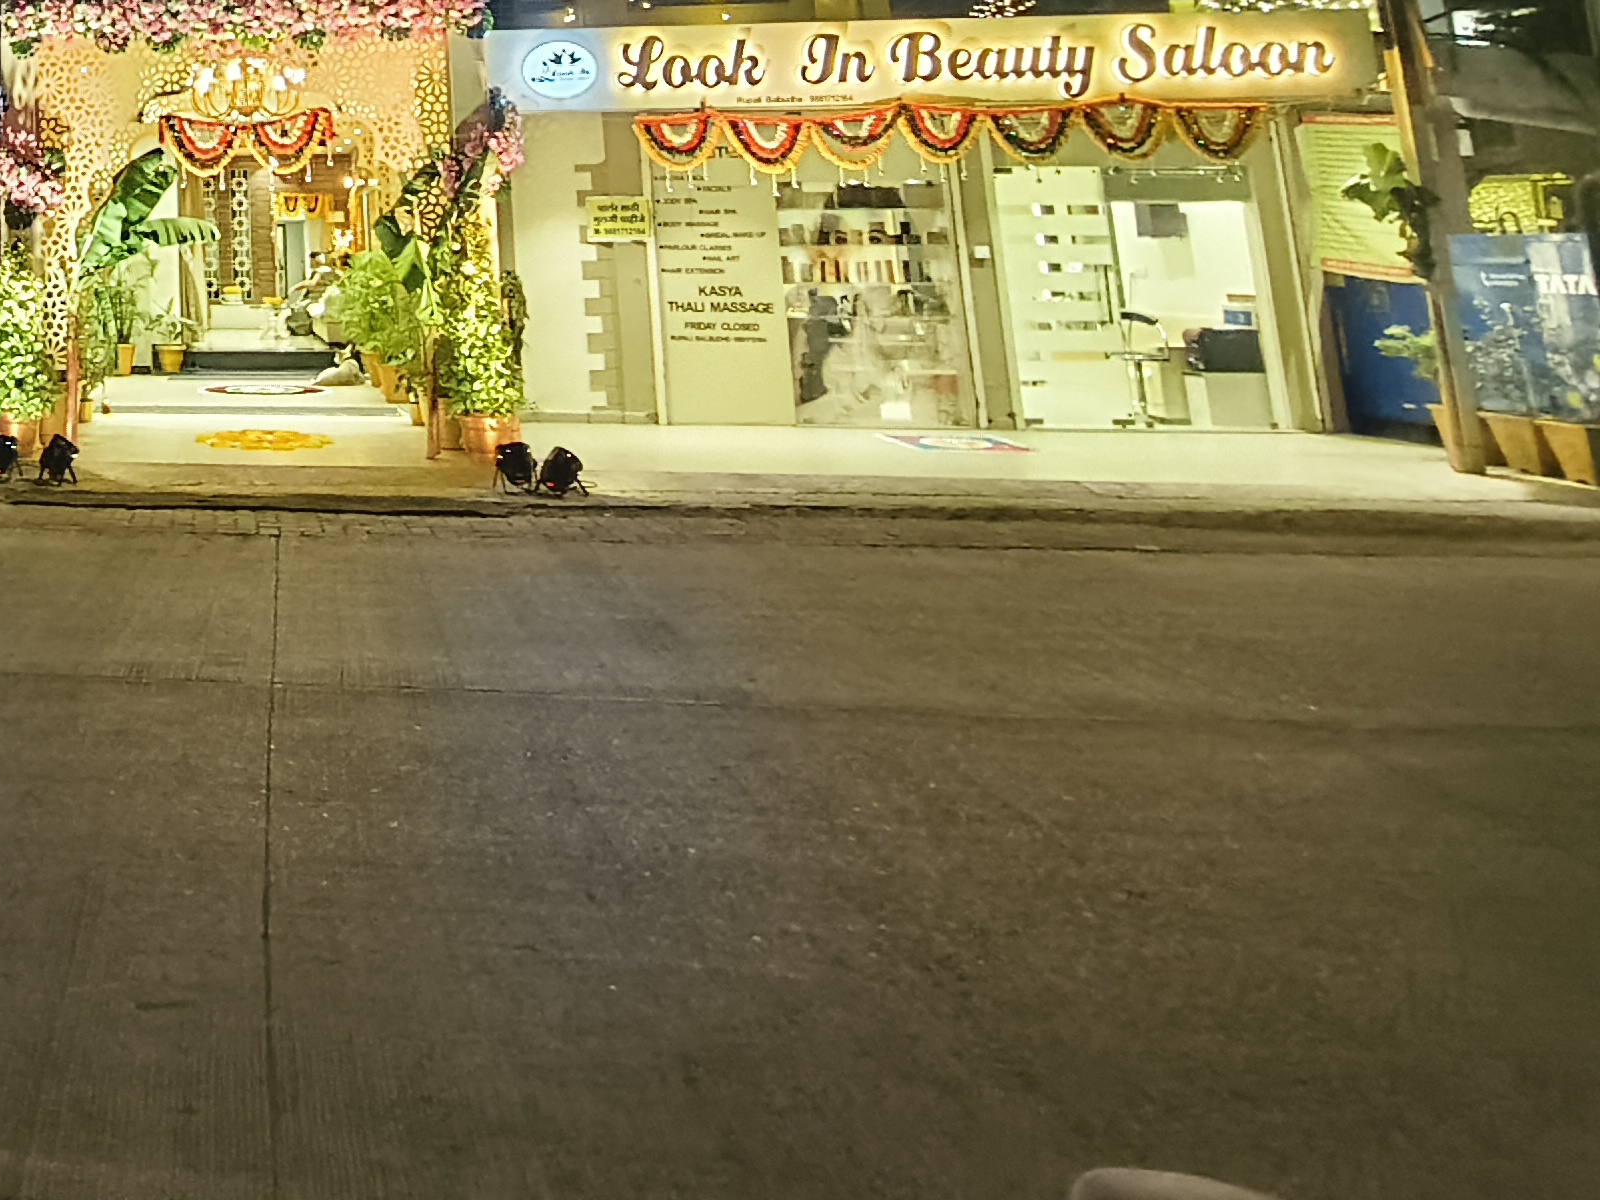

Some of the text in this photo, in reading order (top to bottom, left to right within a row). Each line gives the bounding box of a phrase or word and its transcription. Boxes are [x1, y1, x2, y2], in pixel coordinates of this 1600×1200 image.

[617, 22, 1335, 98] Look In Beauty Saloon
[697, 285, 744, 297] KASYA
[1533, 273, 1599, 296] TATA
[666, 301, 775, 314] THALI MASSAGE
[684, 321, 760, 331] FRIDAY CLOSED
